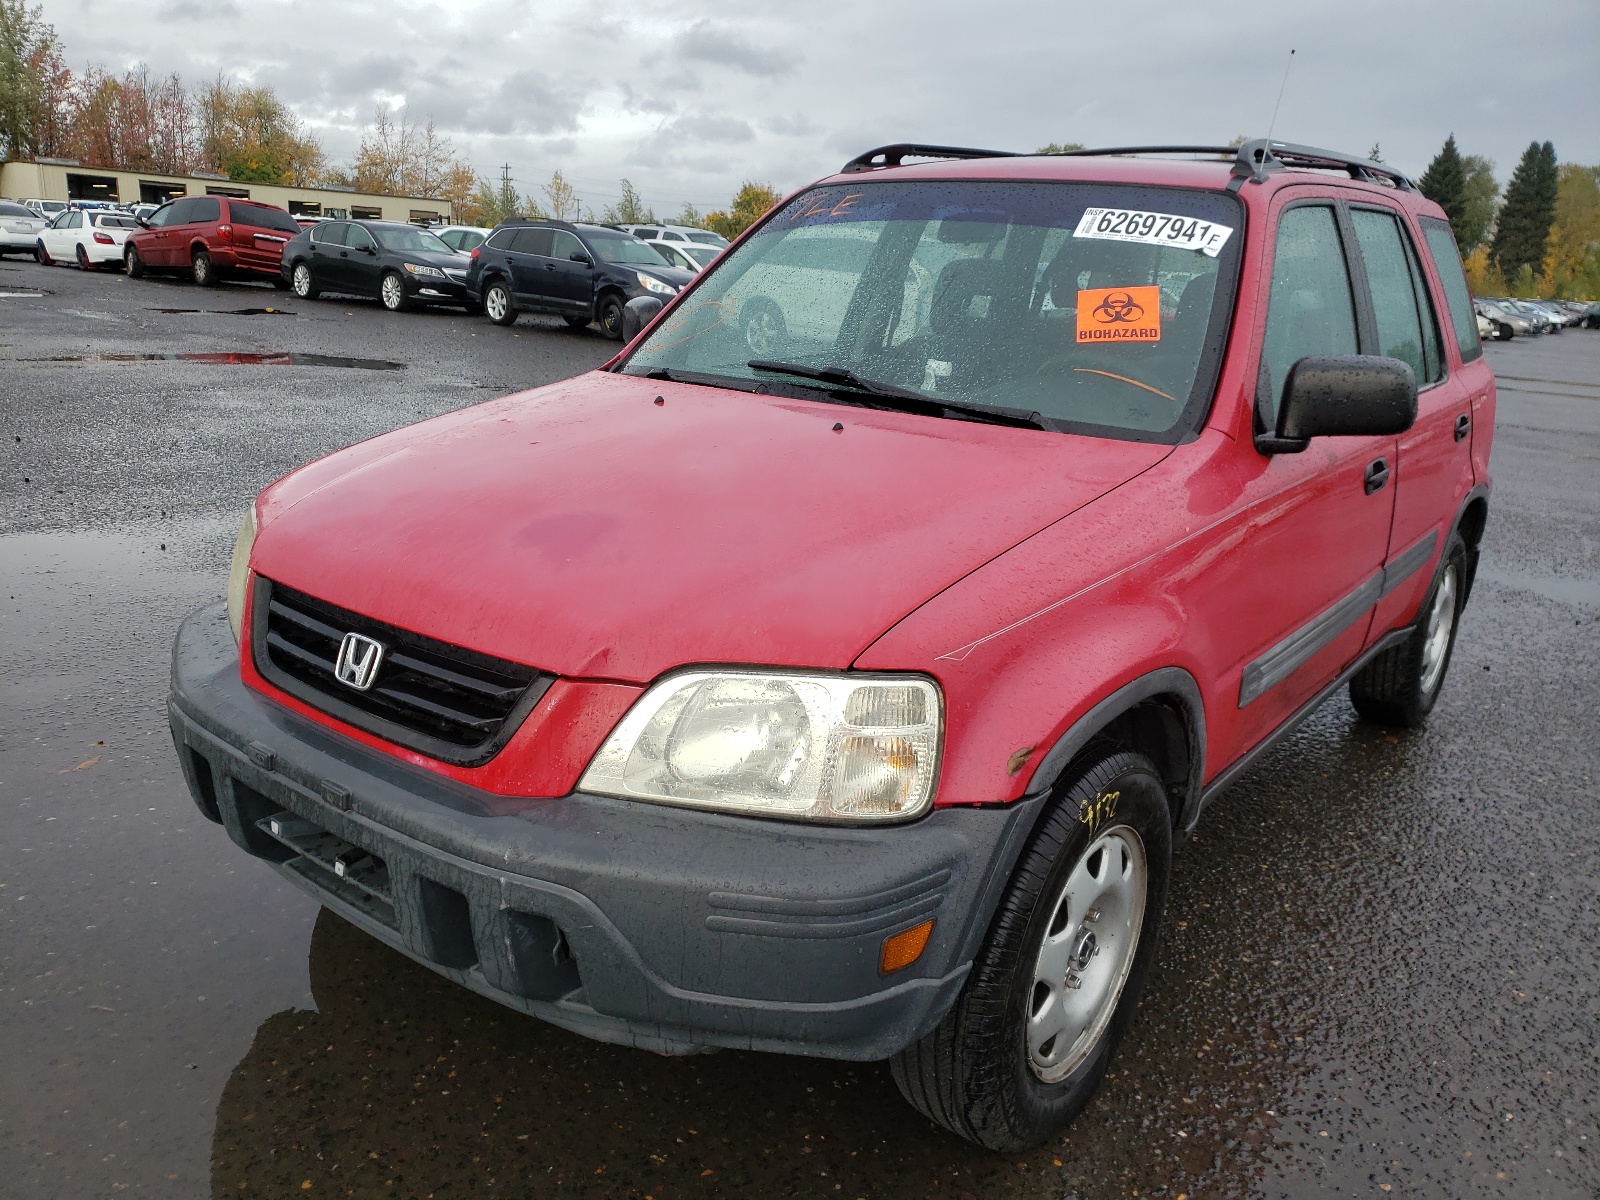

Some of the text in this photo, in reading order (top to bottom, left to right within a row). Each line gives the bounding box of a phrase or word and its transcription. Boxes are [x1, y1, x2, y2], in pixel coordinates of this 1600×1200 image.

[1085, 208, 1104, 216] INSP
[1097, 210, 1212, 243] 62697941
[1207, 233, 1221, 246] F
[1079, 328, 1158, 340] BIOHAZARD
